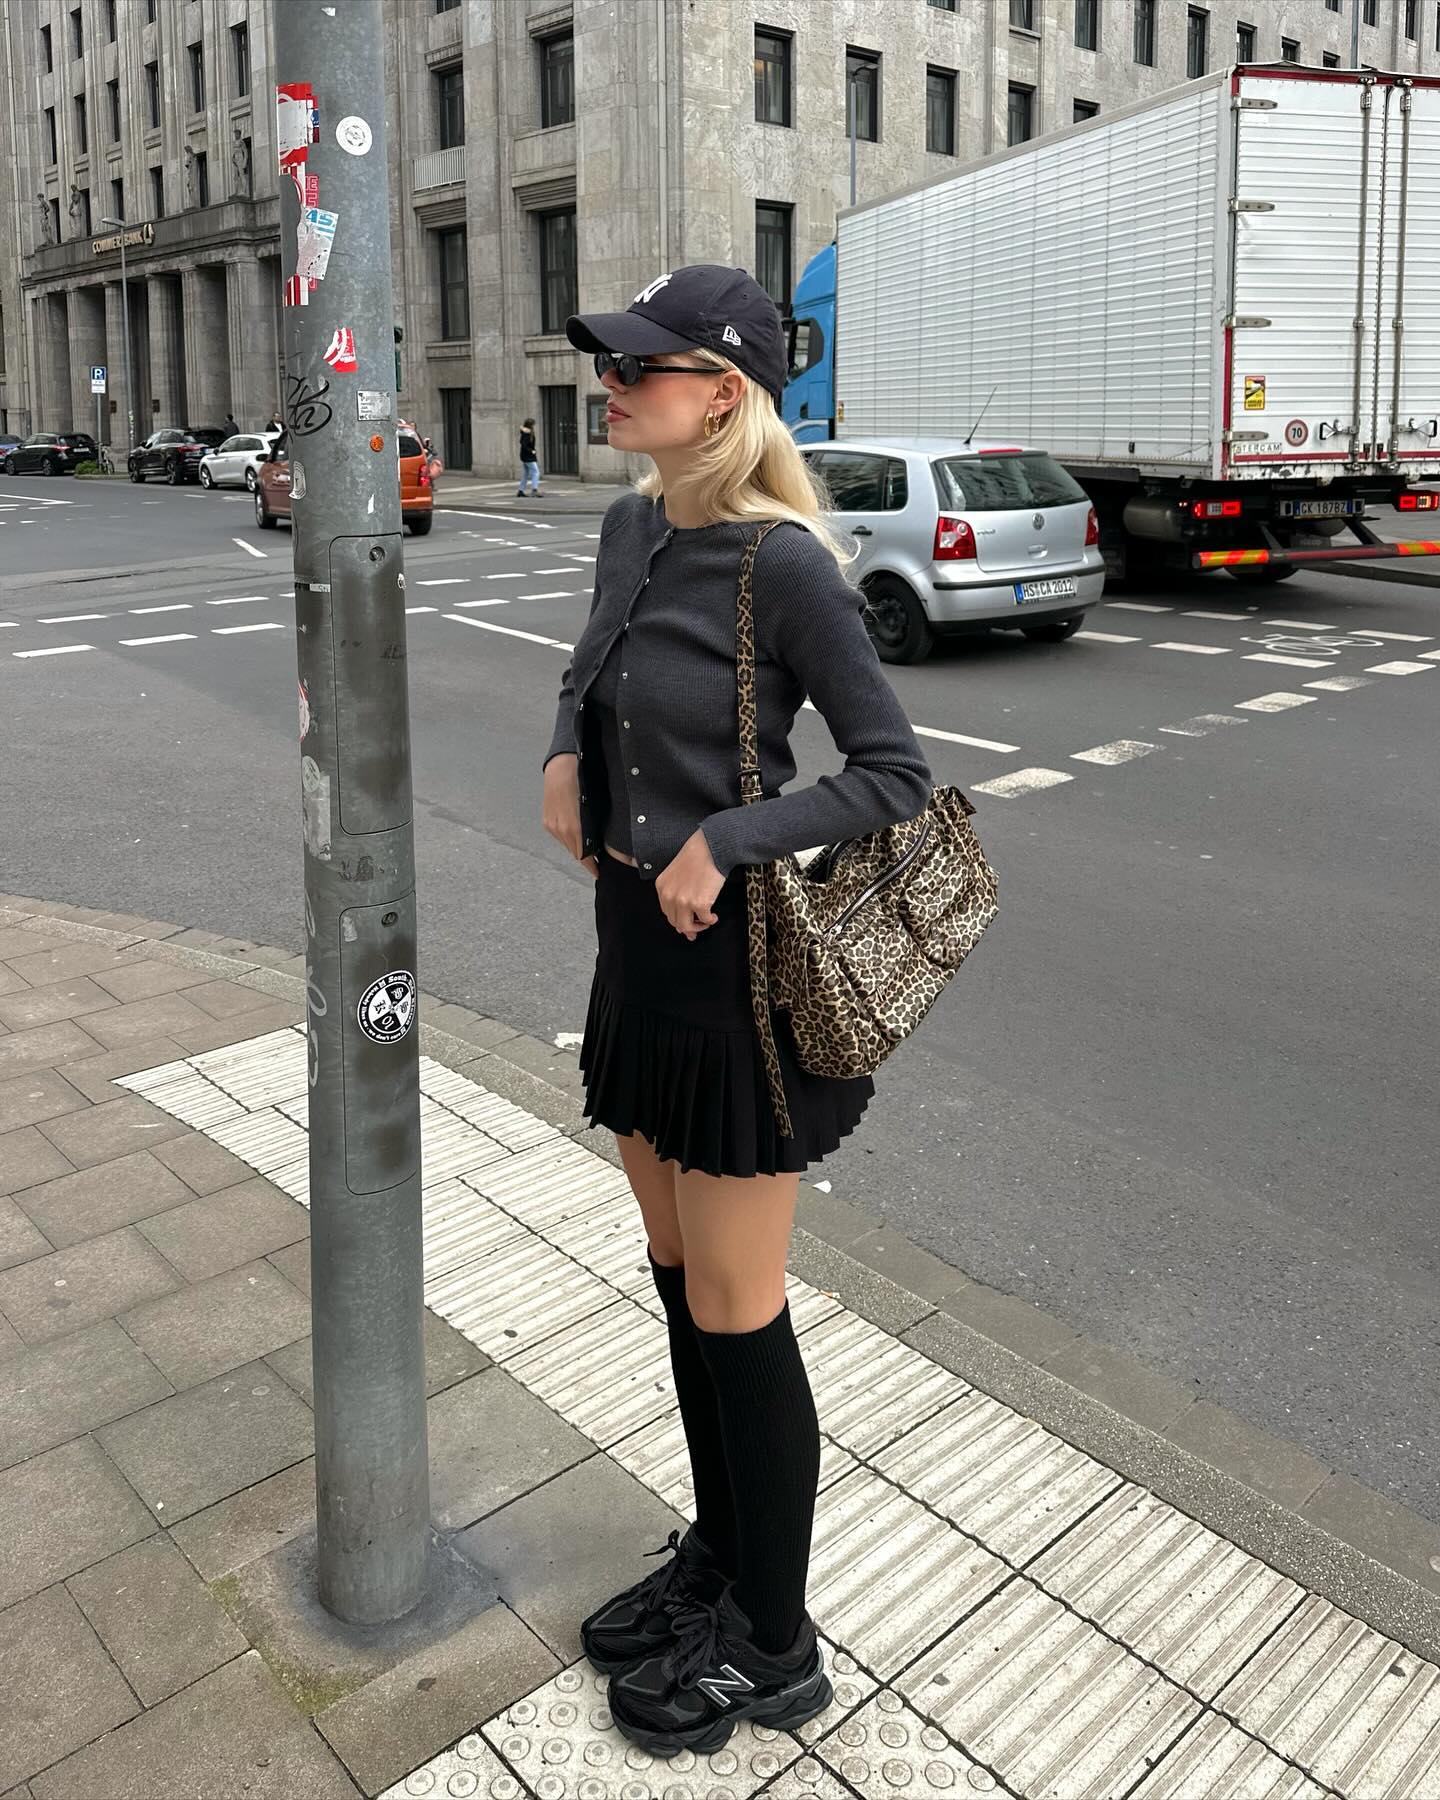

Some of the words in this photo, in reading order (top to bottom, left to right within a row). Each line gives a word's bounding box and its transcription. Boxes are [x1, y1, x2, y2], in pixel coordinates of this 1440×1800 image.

[1291, 427, 1302, 439] 70
[1023, 584, 1035, 598] HS
[1039, 582, 1052, 595] CA
[1052, 579, 1073, 594] 2012
[696, 1664, 755, 1707] N
